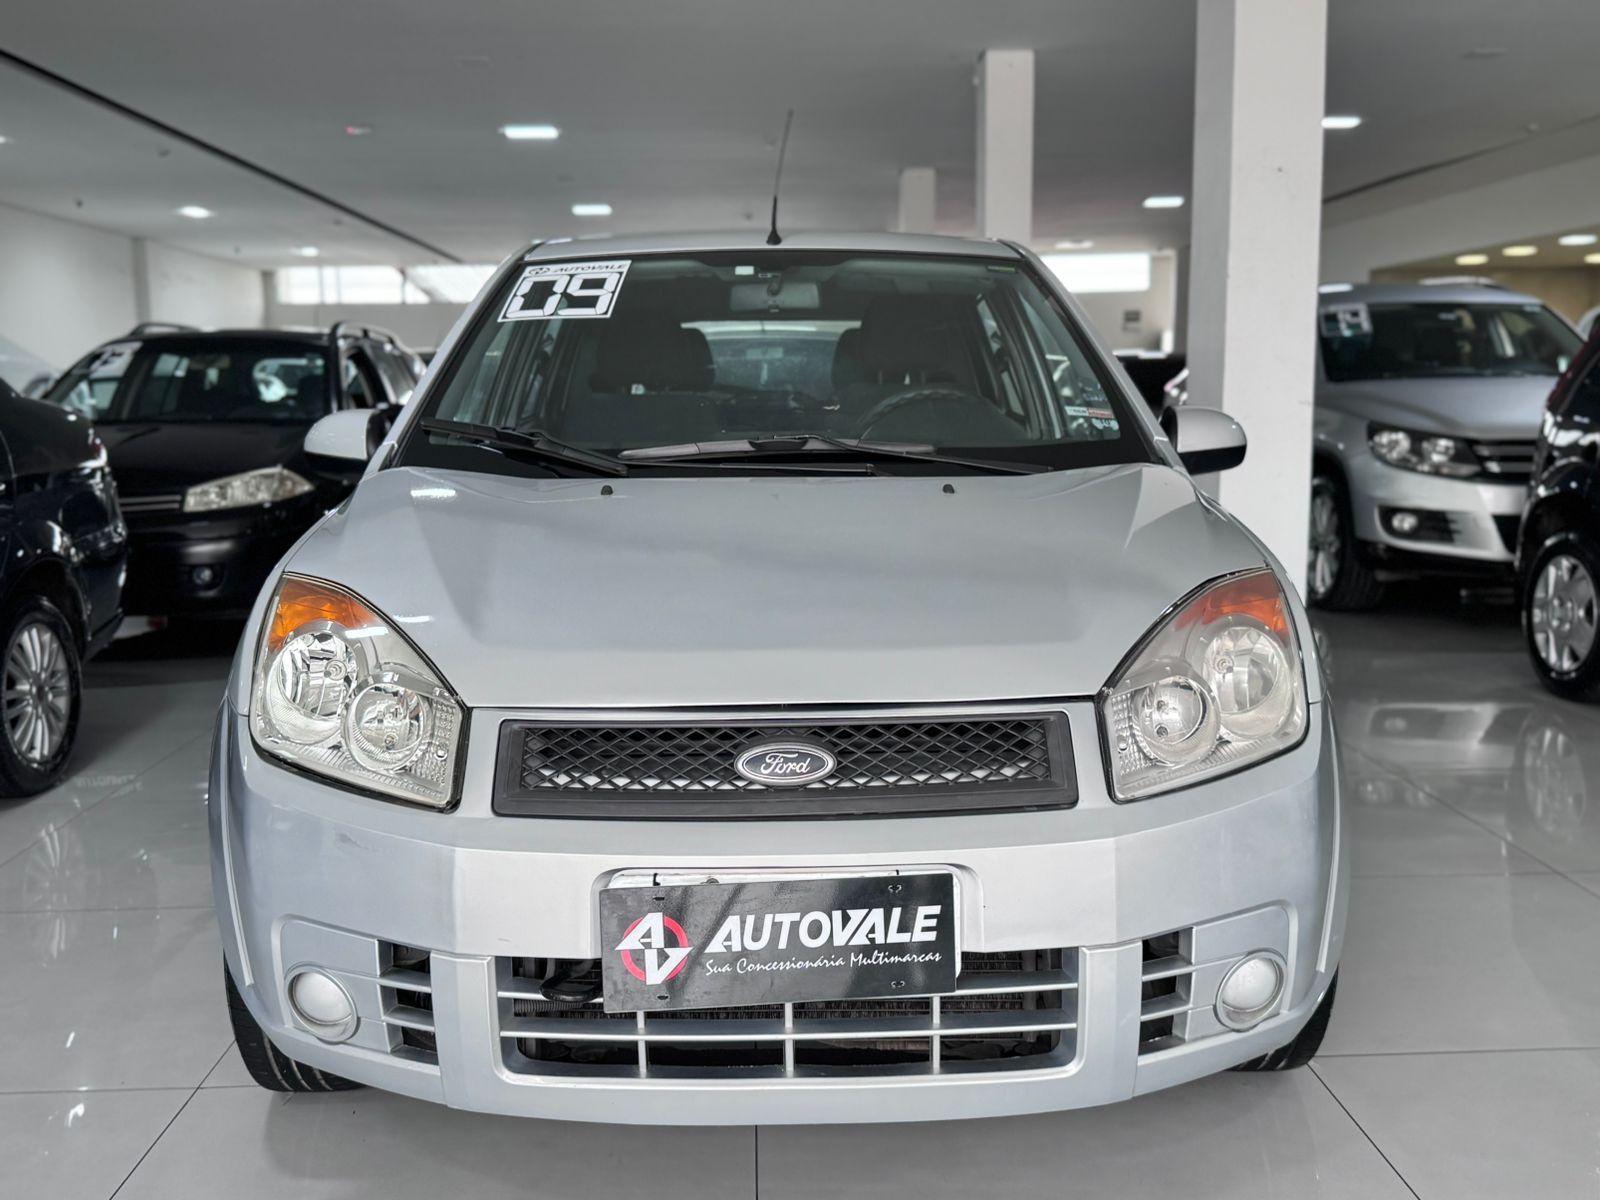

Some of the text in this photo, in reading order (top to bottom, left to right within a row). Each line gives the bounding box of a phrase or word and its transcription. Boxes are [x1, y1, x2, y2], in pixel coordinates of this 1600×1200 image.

[553, 263, 627, 272] AUTOVALE
[505, 272, 620, 318] 09
[760, 753, 811, 774] Ford
[704, 905, 942, 953] AUTOVALE
[705, 949, 942, 976] Sua Concessionária Multimarcas
